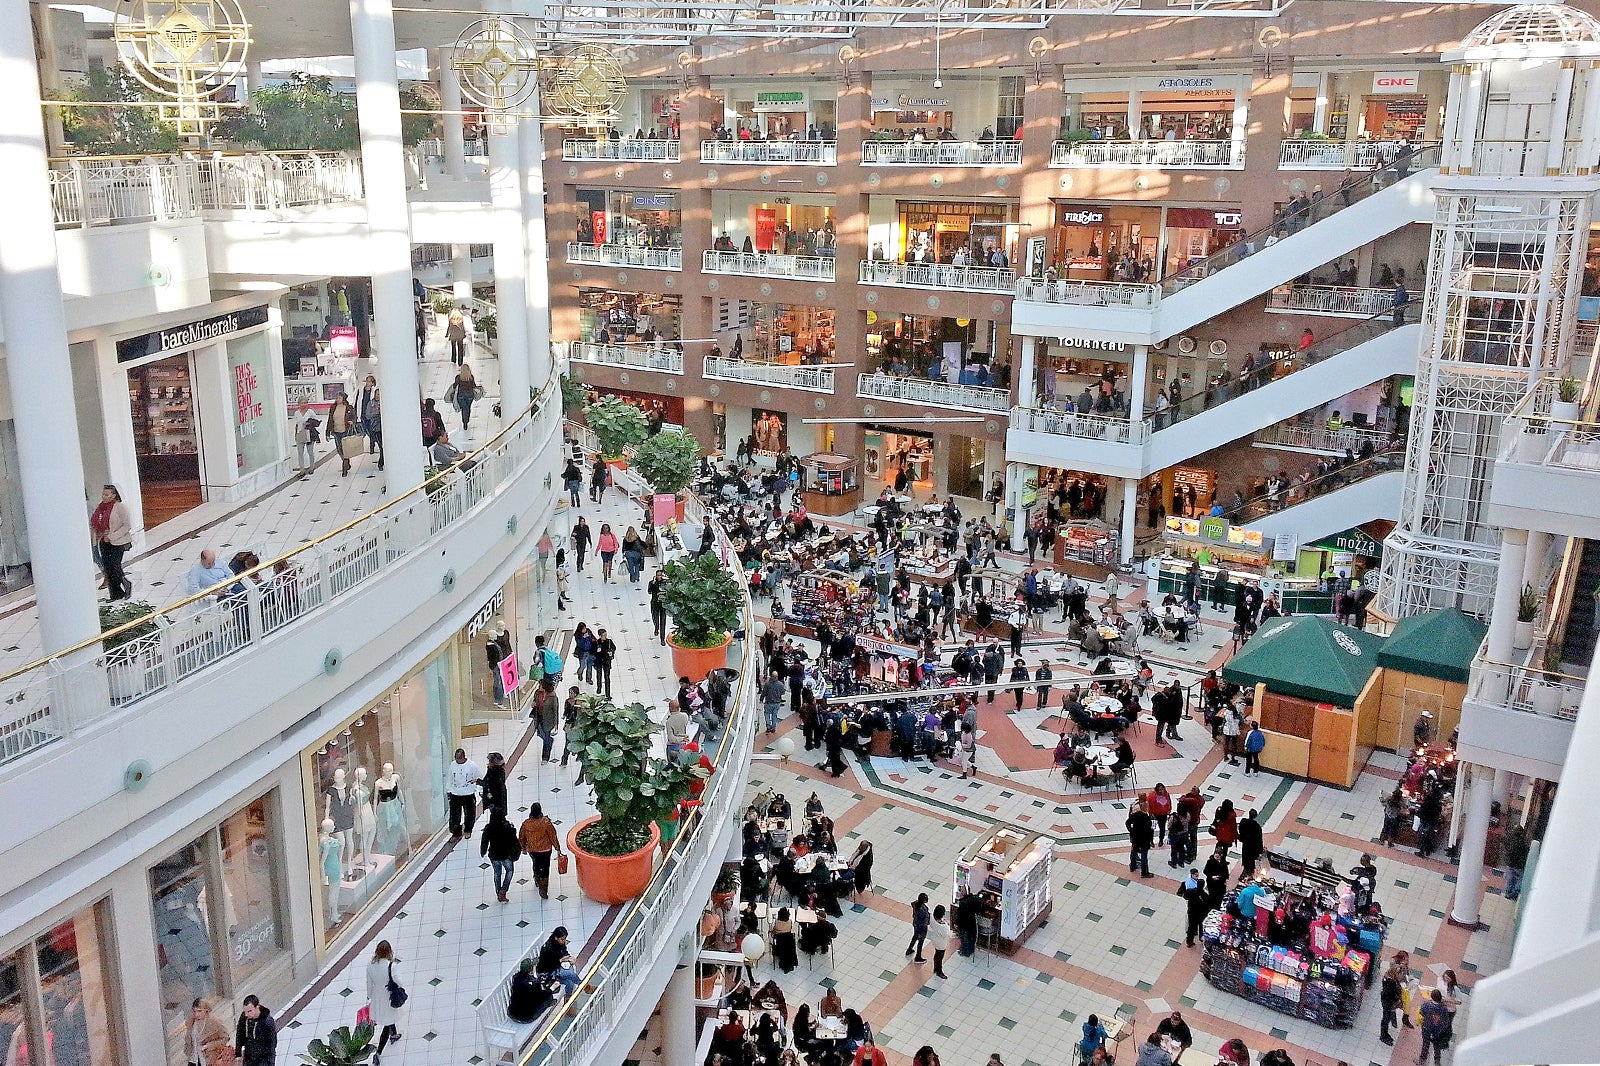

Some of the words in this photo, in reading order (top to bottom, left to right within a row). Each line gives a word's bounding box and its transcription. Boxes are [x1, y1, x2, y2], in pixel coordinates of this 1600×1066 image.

[1158, 78, 1213, 88] AEROSOLES
[1376, 78, 1415, 86] GNC
[160, 314, 238, 351] bareMinerals
[1057, 336, 1126, 352] TOURNEAU
[234, 362, 251, 380] THIS
[236, 380, 244, 396] IS
[245, 375, 258, 392] THE
[238, 392, 252, 410] END
[239, 407, 248, 425] OF
[249, 402, 263, 420] THE
[240, 421, 257, 438] LINE
[1336, 537, 1375, 552] mozza
